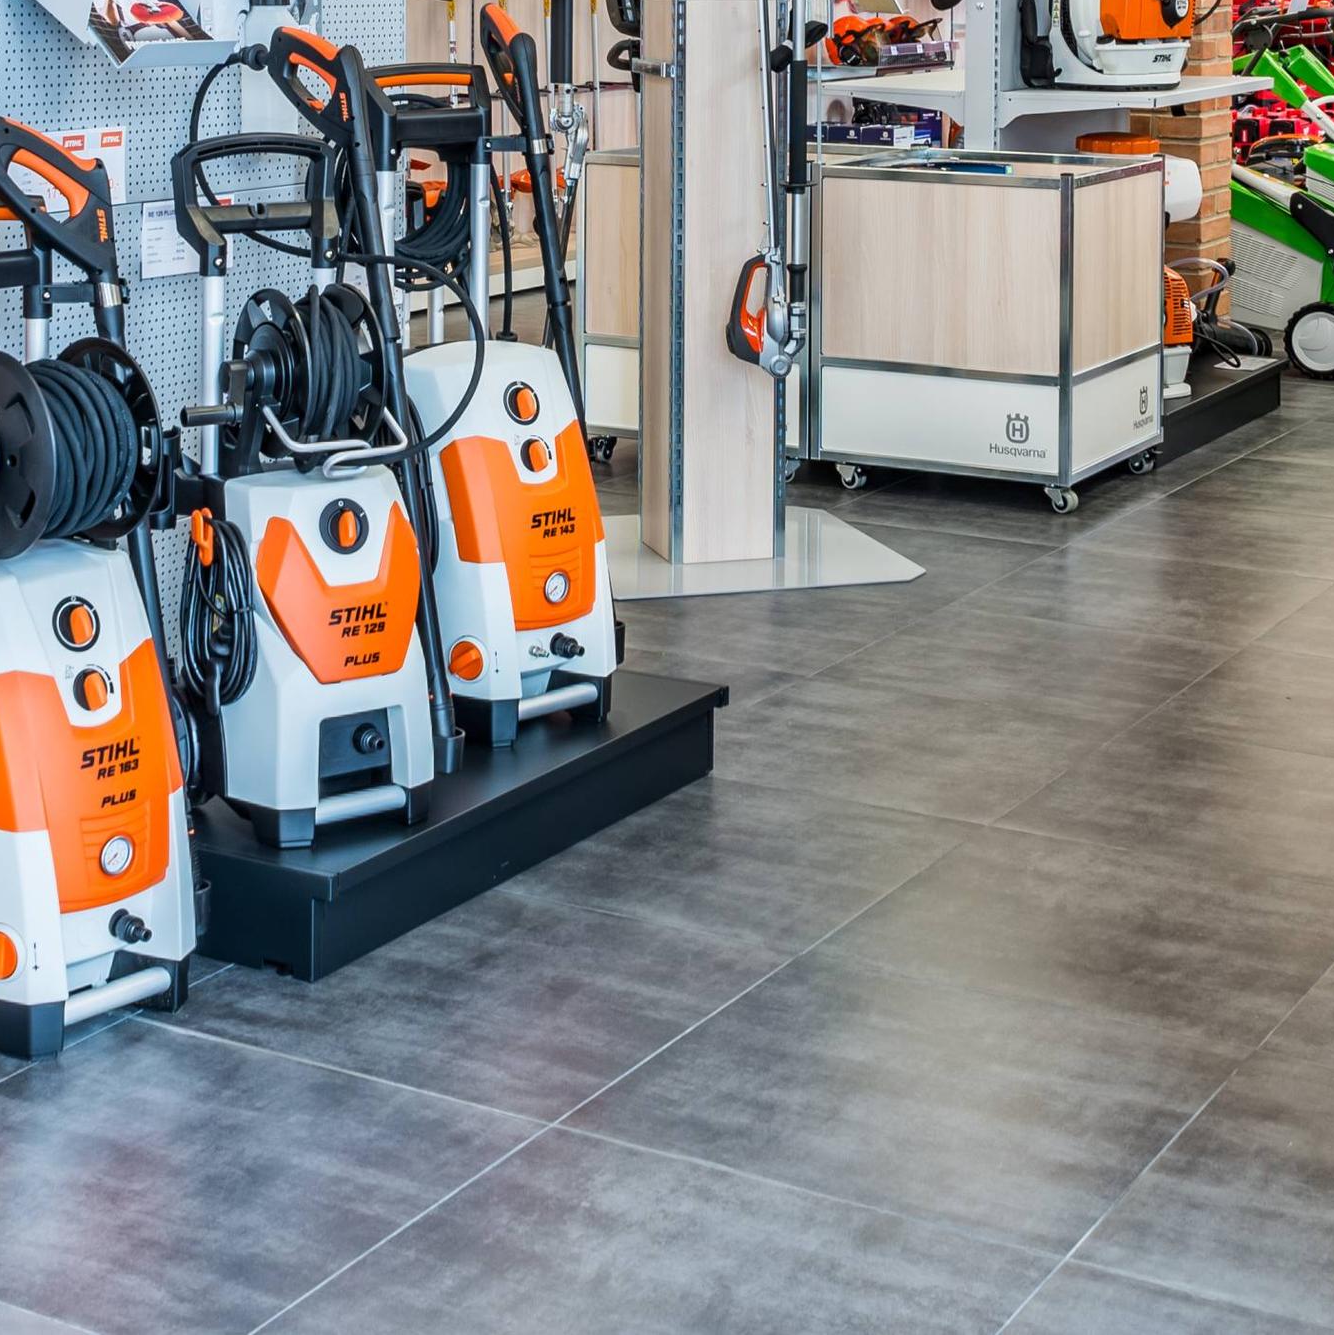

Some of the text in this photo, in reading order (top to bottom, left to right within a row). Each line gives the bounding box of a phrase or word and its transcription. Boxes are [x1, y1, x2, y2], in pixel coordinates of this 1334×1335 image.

[1152, 53, 1173, 63] STIHL
[339, 92, 348, 122] STIHL
[64, 139, 83, 149] STIHL
[102, 135, 121, 144] STIHL
[96, 208, 108, 243] STIHL
[989, 443, 1046, 459] Husqvarna
[531, 507, 576, 529] STIHL
[543, 524, 575, 538] RE 143
[328, 602, 387, 626] STIHL
[341, 625, 361, 638] RE
[344, 652, 380, 667] PLUS
[80, 738, 140, 770] STIHL
[97, 758, 139, 780] RE 163
[101, 789, 136, 808] PLUS
